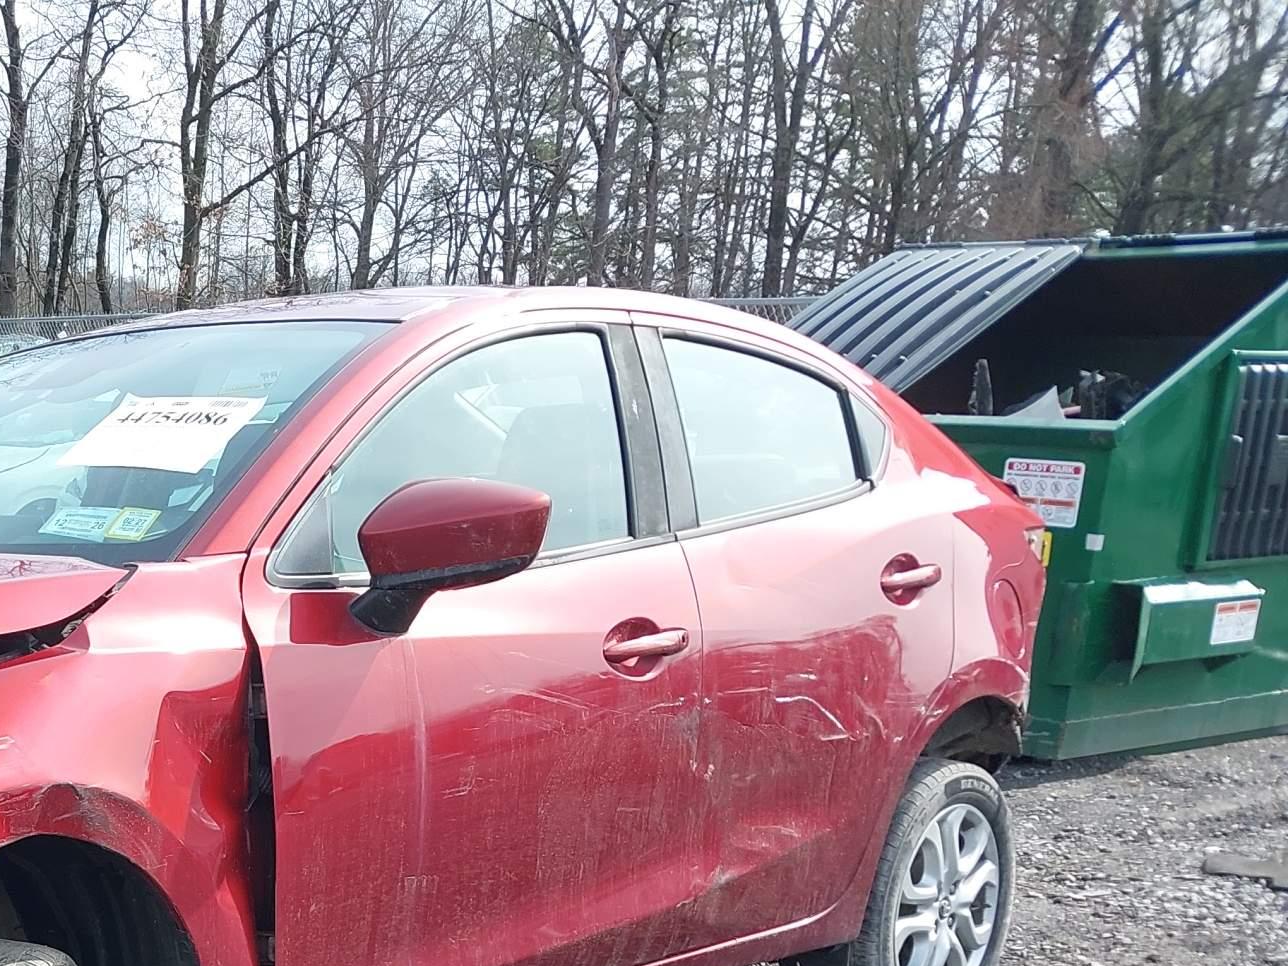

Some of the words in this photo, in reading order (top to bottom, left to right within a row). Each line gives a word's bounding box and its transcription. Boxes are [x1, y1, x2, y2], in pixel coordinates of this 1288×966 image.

[116, 411, 233, 426] 44754086
[1013, 463, 1027, 471] DO
[1028, 464, 1049, 473] NOT
[1050, 466, 1075, 475] PARK
[54, 518, 68, 527] 12
